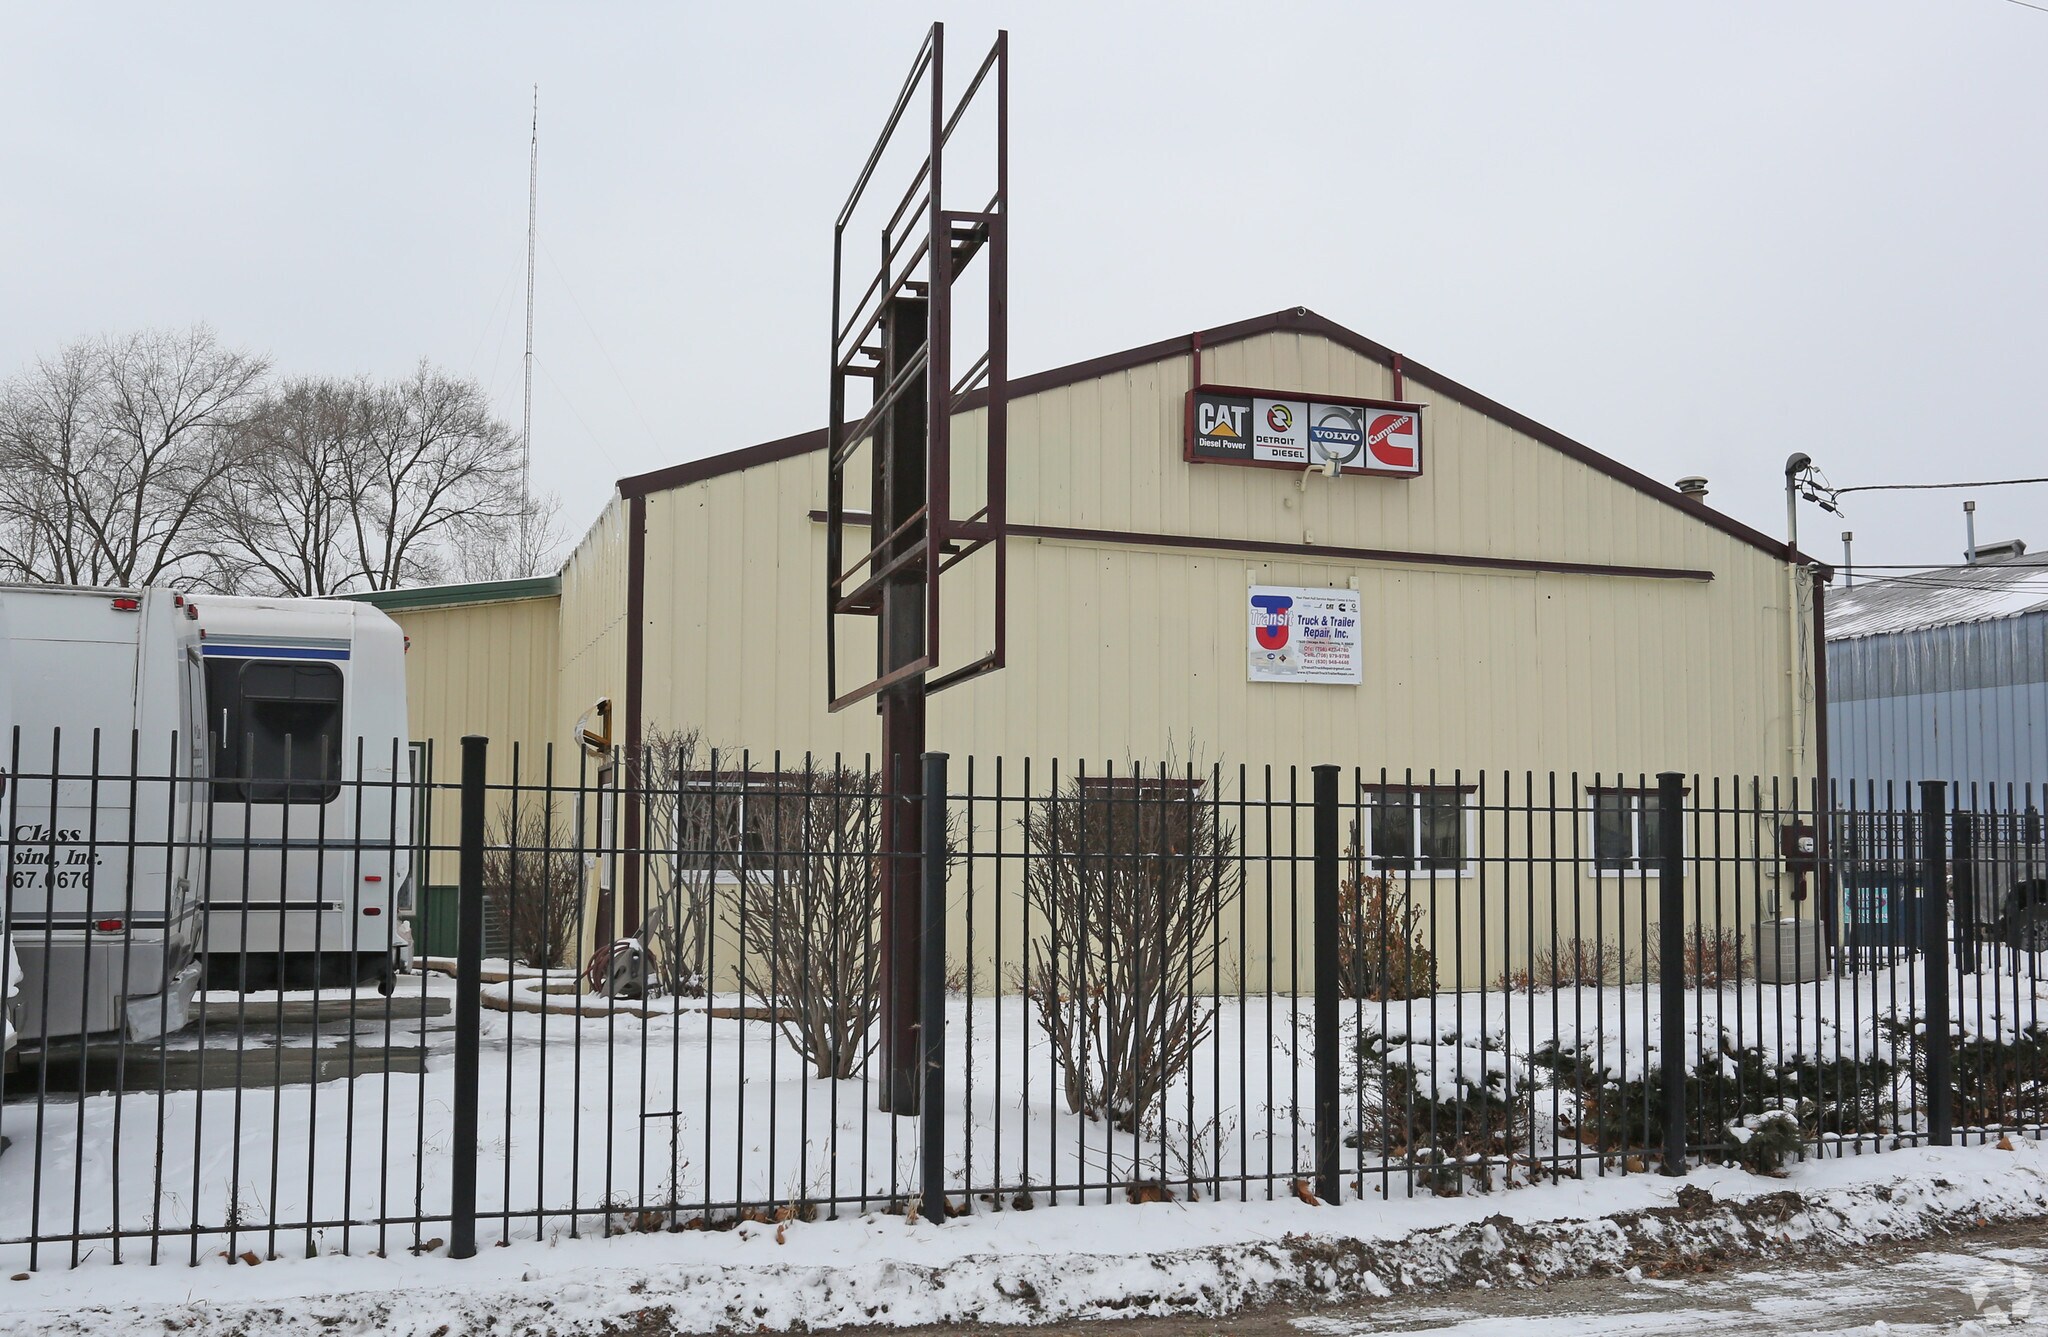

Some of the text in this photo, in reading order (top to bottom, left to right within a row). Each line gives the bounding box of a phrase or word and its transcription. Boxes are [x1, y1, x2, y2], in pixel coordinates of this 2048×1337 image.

[1313, 430, 1360, 442] VOLVO
[1368, 415, 1409, 445] Cummins
[1200, 438, 1246, 450] Diesel Power
[1256, 436, 1295, 446] DETROIT
[1272, 449, 1305, 459] DIESEL
[1251, 609, 1294, 626] Transit
[1298, 615, 1355, 627] Truck & Trailer
[1304, 627, 1349, 639] Repair, Inc.
[15, 824, 81, 842] Class
